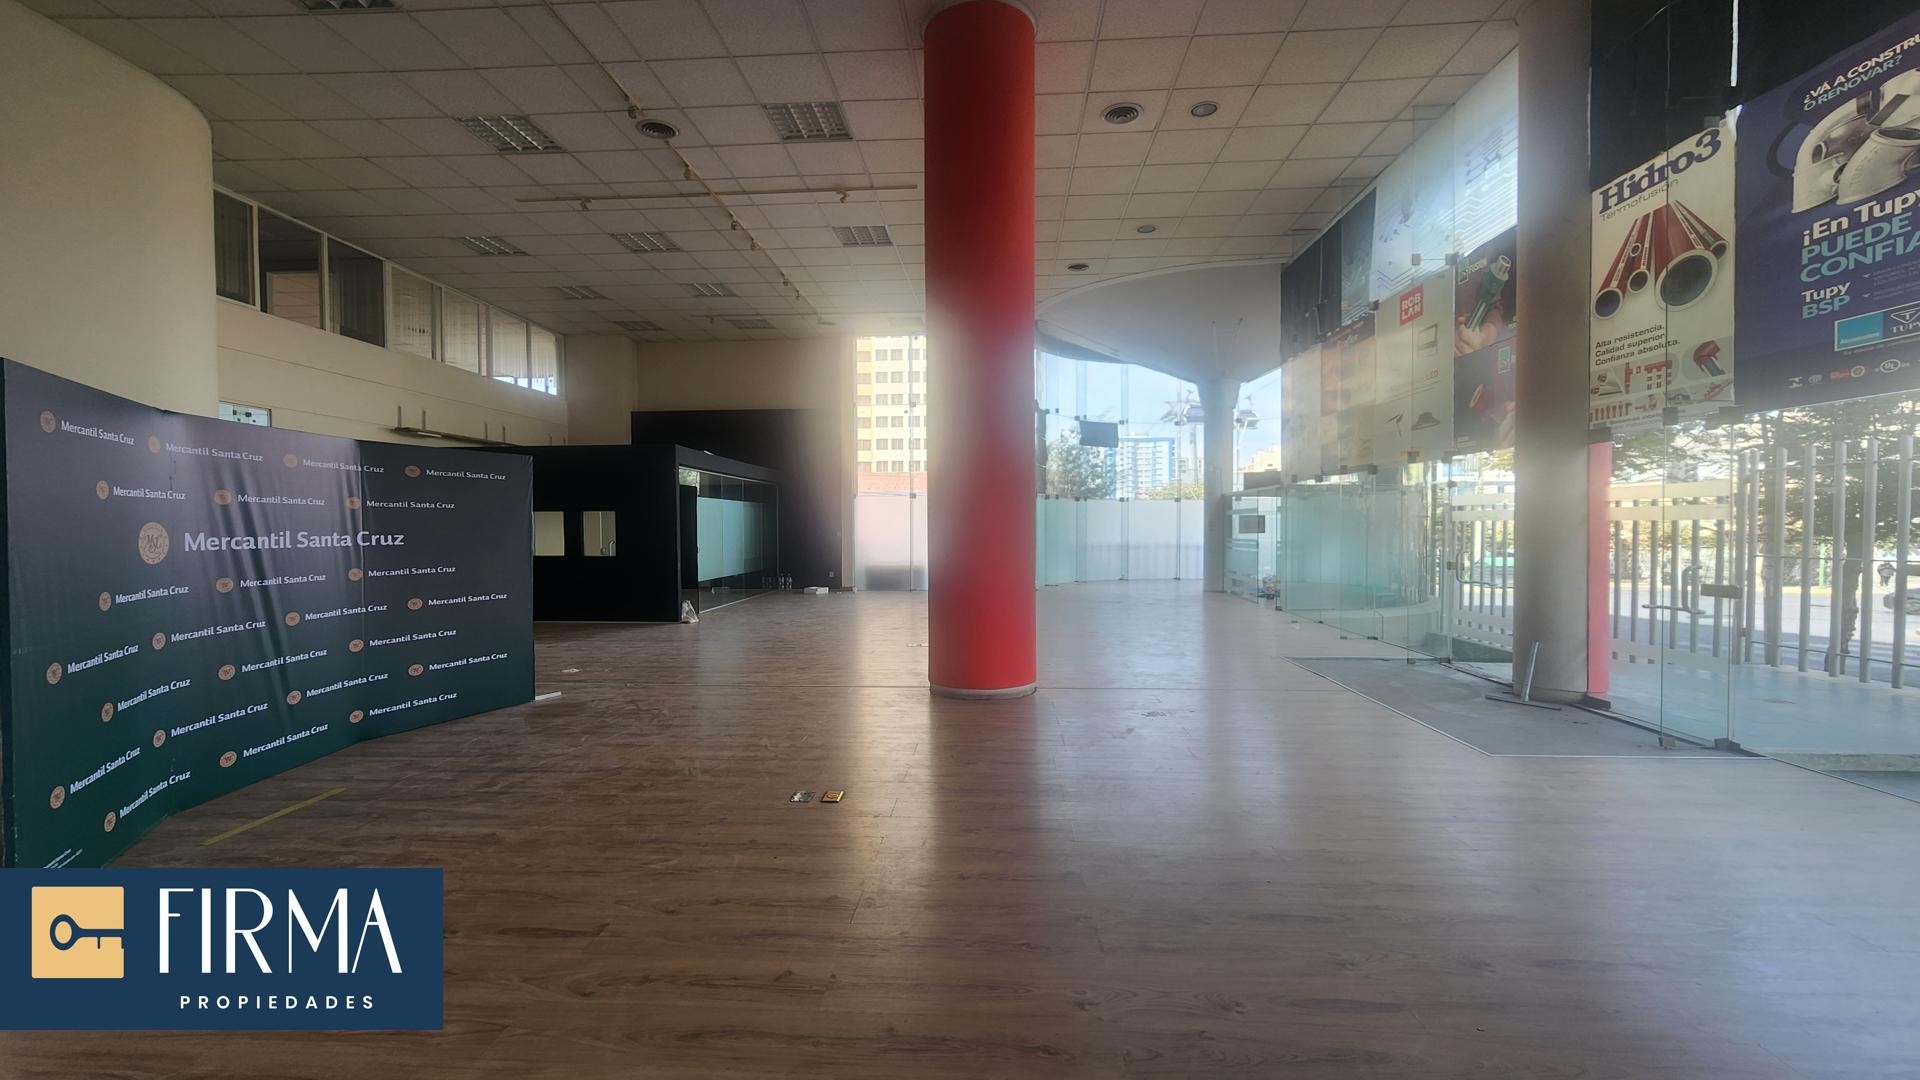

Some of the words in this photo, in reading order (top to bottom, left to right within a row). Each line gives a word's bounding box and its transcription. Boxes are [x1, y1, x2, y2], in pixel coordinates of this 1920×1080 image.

[1803, 100, 1816, 111] O
[1818, 55, 1903, 104] RENOVAR?
[1833, 75, 1846, 87] A
[1599, 128, 1722, 215] Hidro3
[1801, 212, 1912, 265] PUEDE
[1803, 216, 1849, 246] ¡En
[1801, 282, 1851, 303] Tupy
[1401, 303, 1421, 320] LAN
[1802, 295, 1850, 319] BSP
[1595, 340, 1612, 349] Alta
[1614, 323, 1665, 343] resistencia.
[1595, 344, 1625, 357] Calidad
[1595, 351, 1636, 366] Confianza
[1637, 340, 1681, 356] absoluta.
[62, 420, 97, 437] Mercantil
[99, 429, 118, 441] Santa
[118, 434, 134, 444] Cruz
[166, 443, 209, 455] Mercantil
[212, 449, 241, 459] Santa
[242, 452, 263, 462] Cruz
[303, 459, 338, 469] Mercantil
[340, 462, 361, 472] Santa
[363, 465, 384, 473] Cruz
[426, 469, 464, 478] Mercantil
[466, 471, 488, 479] Santa
[490, 473, 505, 481] Cruz
[113, 487, 145, 497] Mercantil
[146, 489, 166, 498] Santa
[167, 490, 185, 500] Cruz
[238, 495, 281, 504] Mercantil
[282, 496, 306, 505] Santa
[308, 497, 325, 506] Cruz
[367, 500, 408, 508] Mercantil
[410, 501, 435, 509] Santa
[185, 531, 291, 551] Mercantil
[297, 532, 352, 547] Santa
[356, 531, 404, 547] Cruz
[241, 577, 282, 587] Mercantil
[284, 575, 307, 584] Santa
[309, 574, 326, 582] Cruz
[369, 567, 409, 577] Mercantil
[411, 567, 436, 575] Santa
[116, 589, 146, 603] Mercantil
[147, 588, 168, 598] Santa
[170, 585, 189, 595] Cruz
[429, 596, 466, 605] Mercantil
[305, 609, 341, 620] Mercantil
[343, 606, 366, 616] Santa
[368, 604, 387, 612] Cruz
[171, 627, 214, 642] Mercantil
[217, 624, 244, 634] Santa
[246, 620, 266, 630] Cruz
[370, 635, 410, 646] Mercantil
[413, 632, 437, 641] Santa
[438, 629, 456, 637] Cruz
[68, 654, 103, 673] Mercantil
[104, 650, 123, 662] Santa
[124, 645, 138, 655] Cruz
[242, 657, 283, 672] Mercantil
[286, 654, 309, 663] Santa
[310, 649, 327, 658] Cruz
[429, 659, 467, 670] Mercantil
[469, 655, 490, 664] Santa
[118, 691, 147, 711] Mercantil
[148, 685, 169, 698] Santa
[171, 680, 190, 689] Cruz
[307, 682, 342, 697] Mercantil
[344, 678, 367, 687] Santa
[369, 673, 388, 682] Cruz
[370, 701, 411, 715] Mercantil
[413, 697, 437, 707] Santa
[439, 692, 457, 701] Cruz
[171, 716, 216, 737] Mercantil
[218, 710, 246, 722] Santa
[247, 704, 268, 713] Cruz
[244, 737, 285, 757] Mercantil
[287, 731, 310, 742] Santa
[311, 724, 328, 734] Cruz
[70, 765, 105, 794] Mercantil
[106, 756, 125, 772] Santa
[126, 748, 140, 760] Cruz
[120, 790, 149, 818] Mercantil
[149, 779, 168, 797] Santa
[169, 771, 191, 785] Cruz
